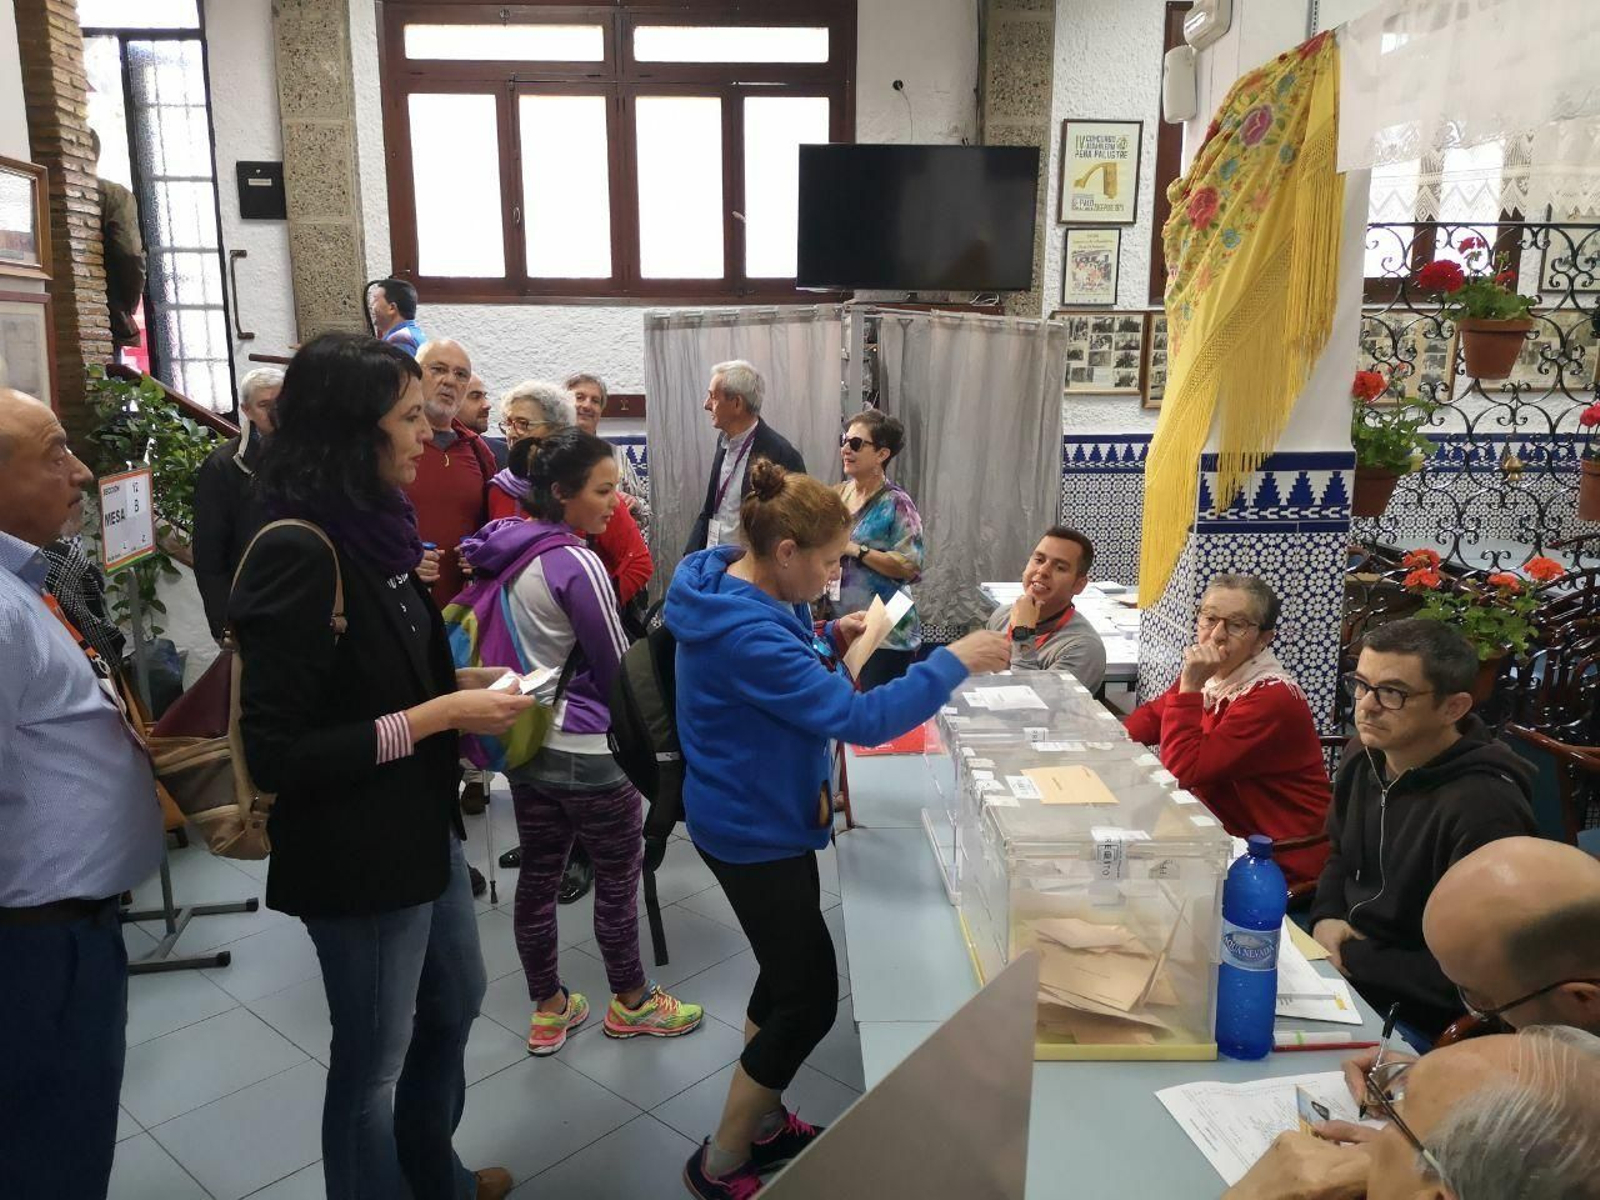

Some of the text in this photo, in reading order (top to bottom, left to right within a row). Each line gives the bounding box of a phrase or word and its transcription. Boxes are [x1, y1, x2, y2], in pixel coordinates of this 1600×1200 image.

[1075, 134, 1085, 150] IV
[1094, 150, 1128, 159] PALUSTRE
[105, 508, 126, 527] MESA
[1243, 944, 1275, 958] NEVADA
